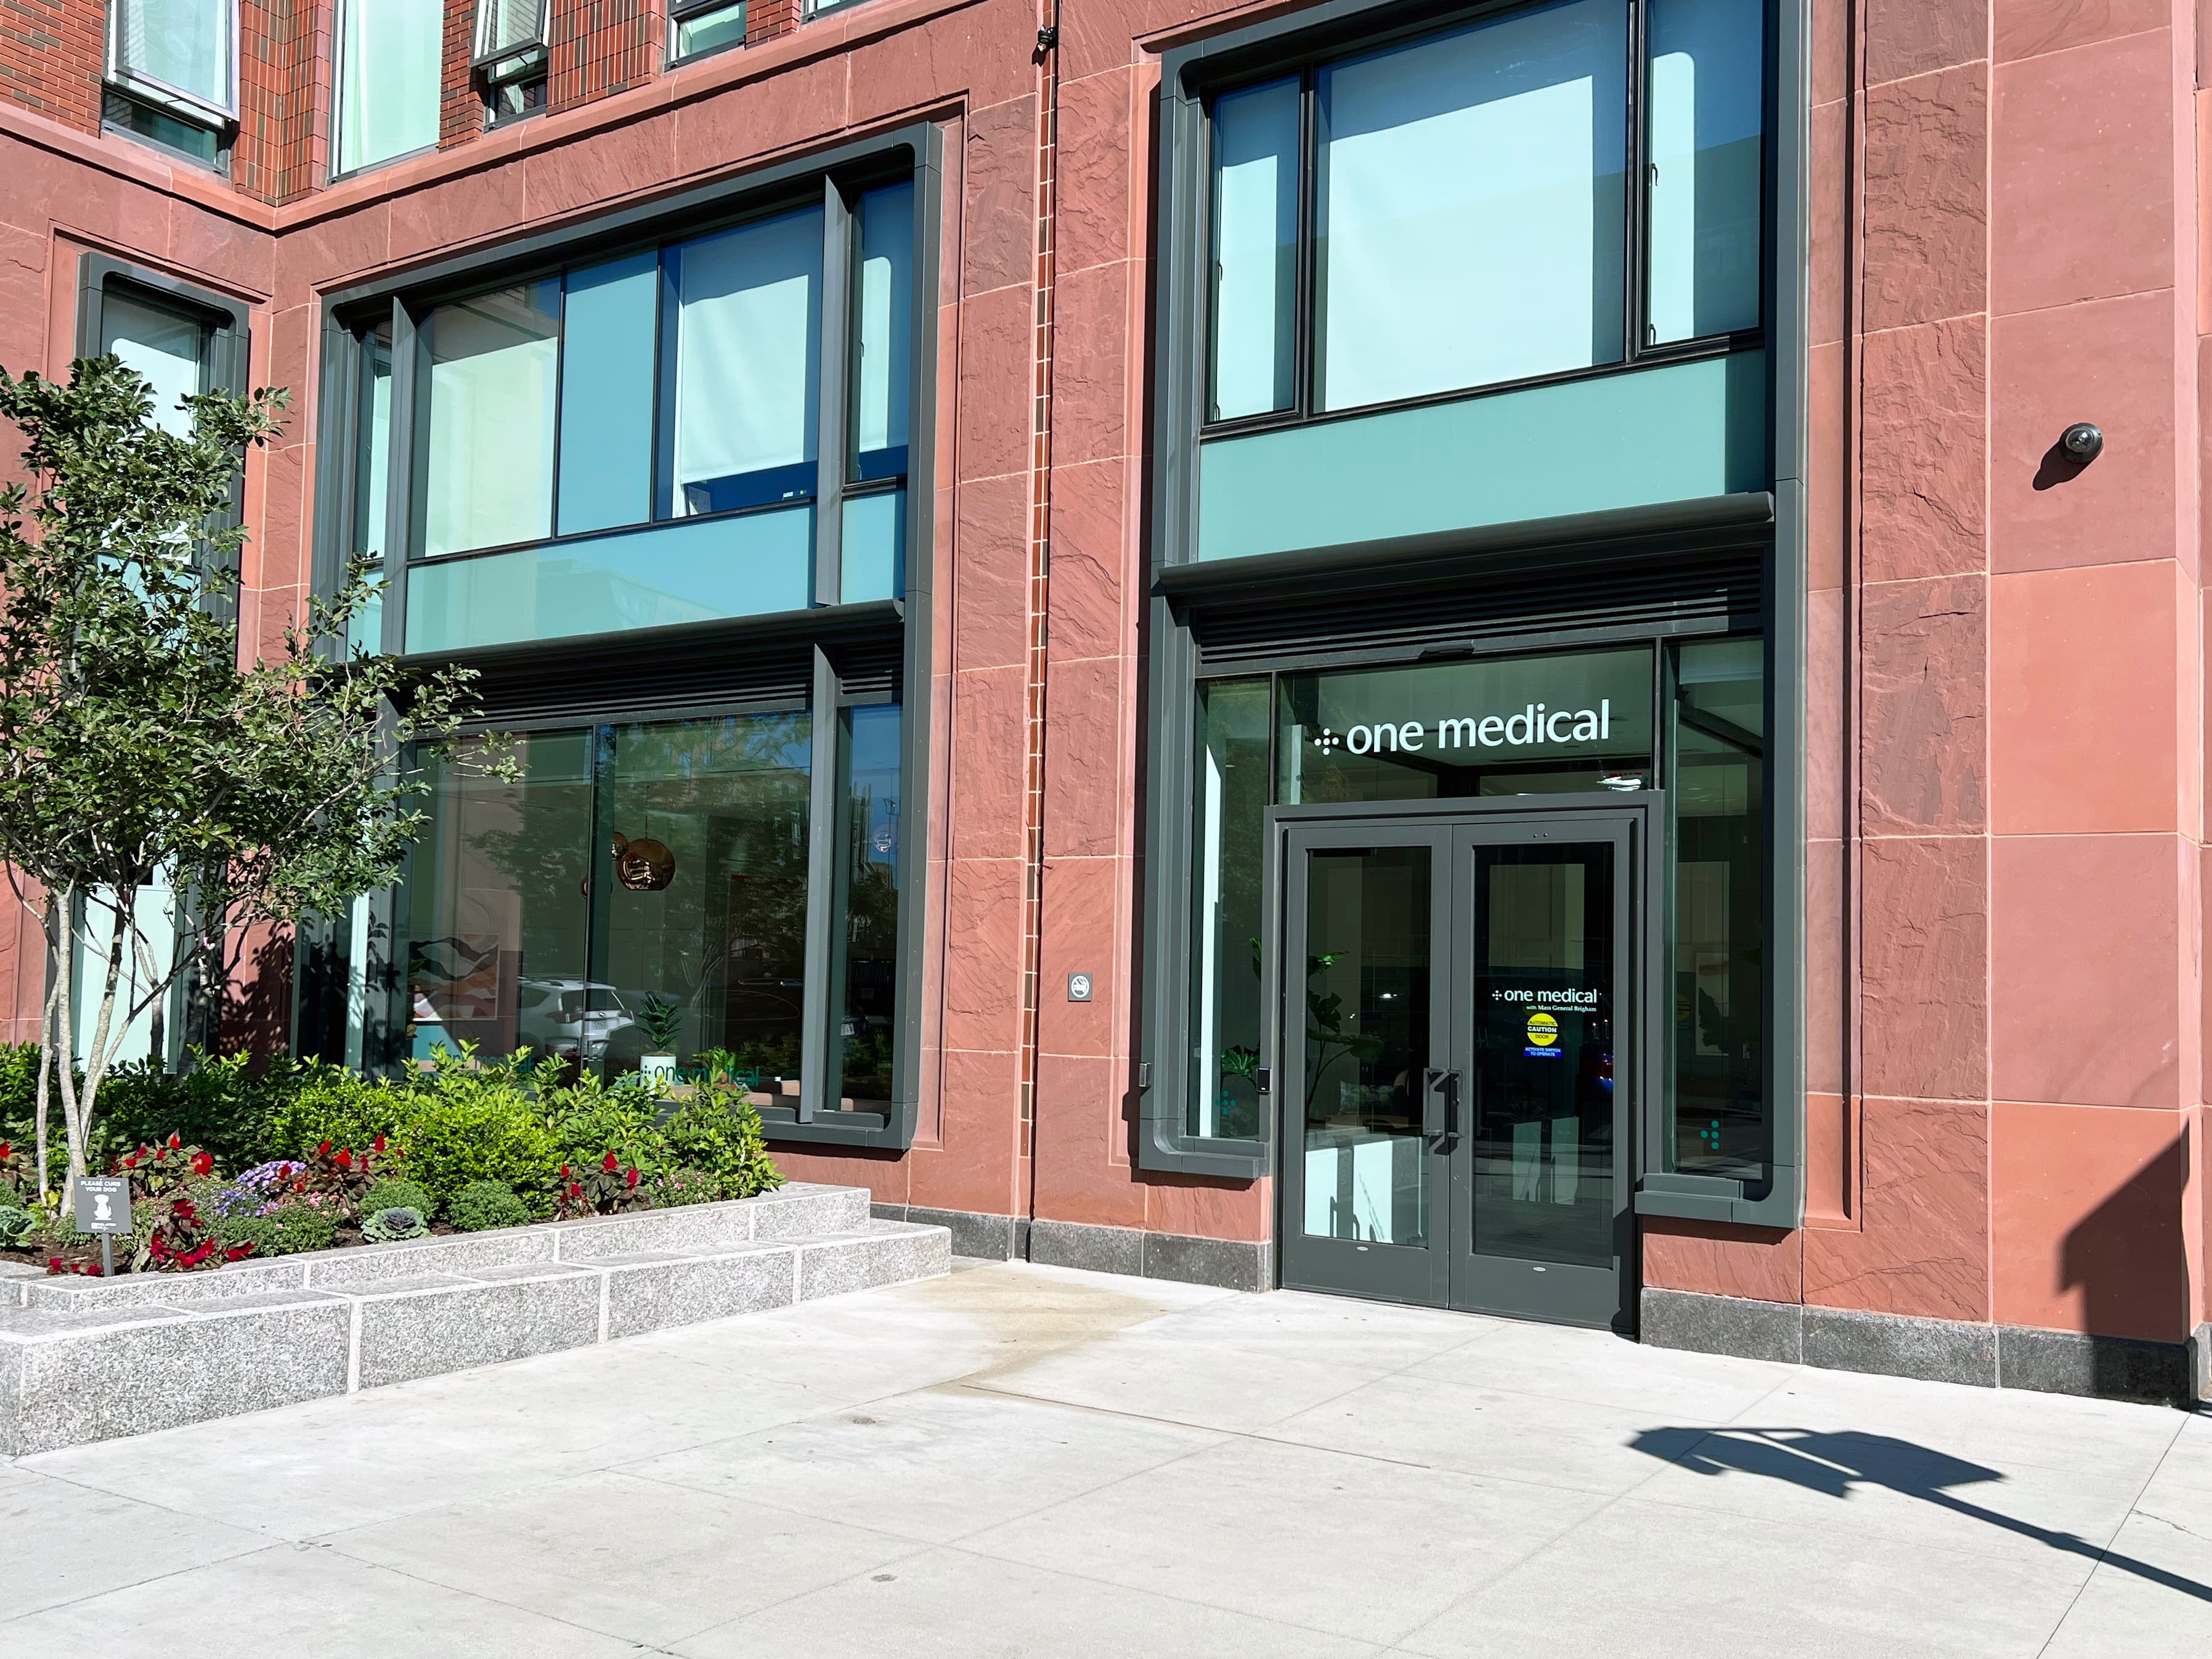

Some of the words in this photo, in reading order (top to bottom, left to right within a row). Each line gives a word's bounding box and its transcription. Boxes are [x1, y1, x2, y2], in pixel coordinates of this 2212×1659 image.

[1347, 721, 1423, 754] one
[1437, 699, 1609, 749] medical
[1504, 990, 1533, 1001] one
[1537, 988, 1597, 1003] medical
[654, 1066, 687, 1082] one
[691, 1064, 760, 1086] mdical
